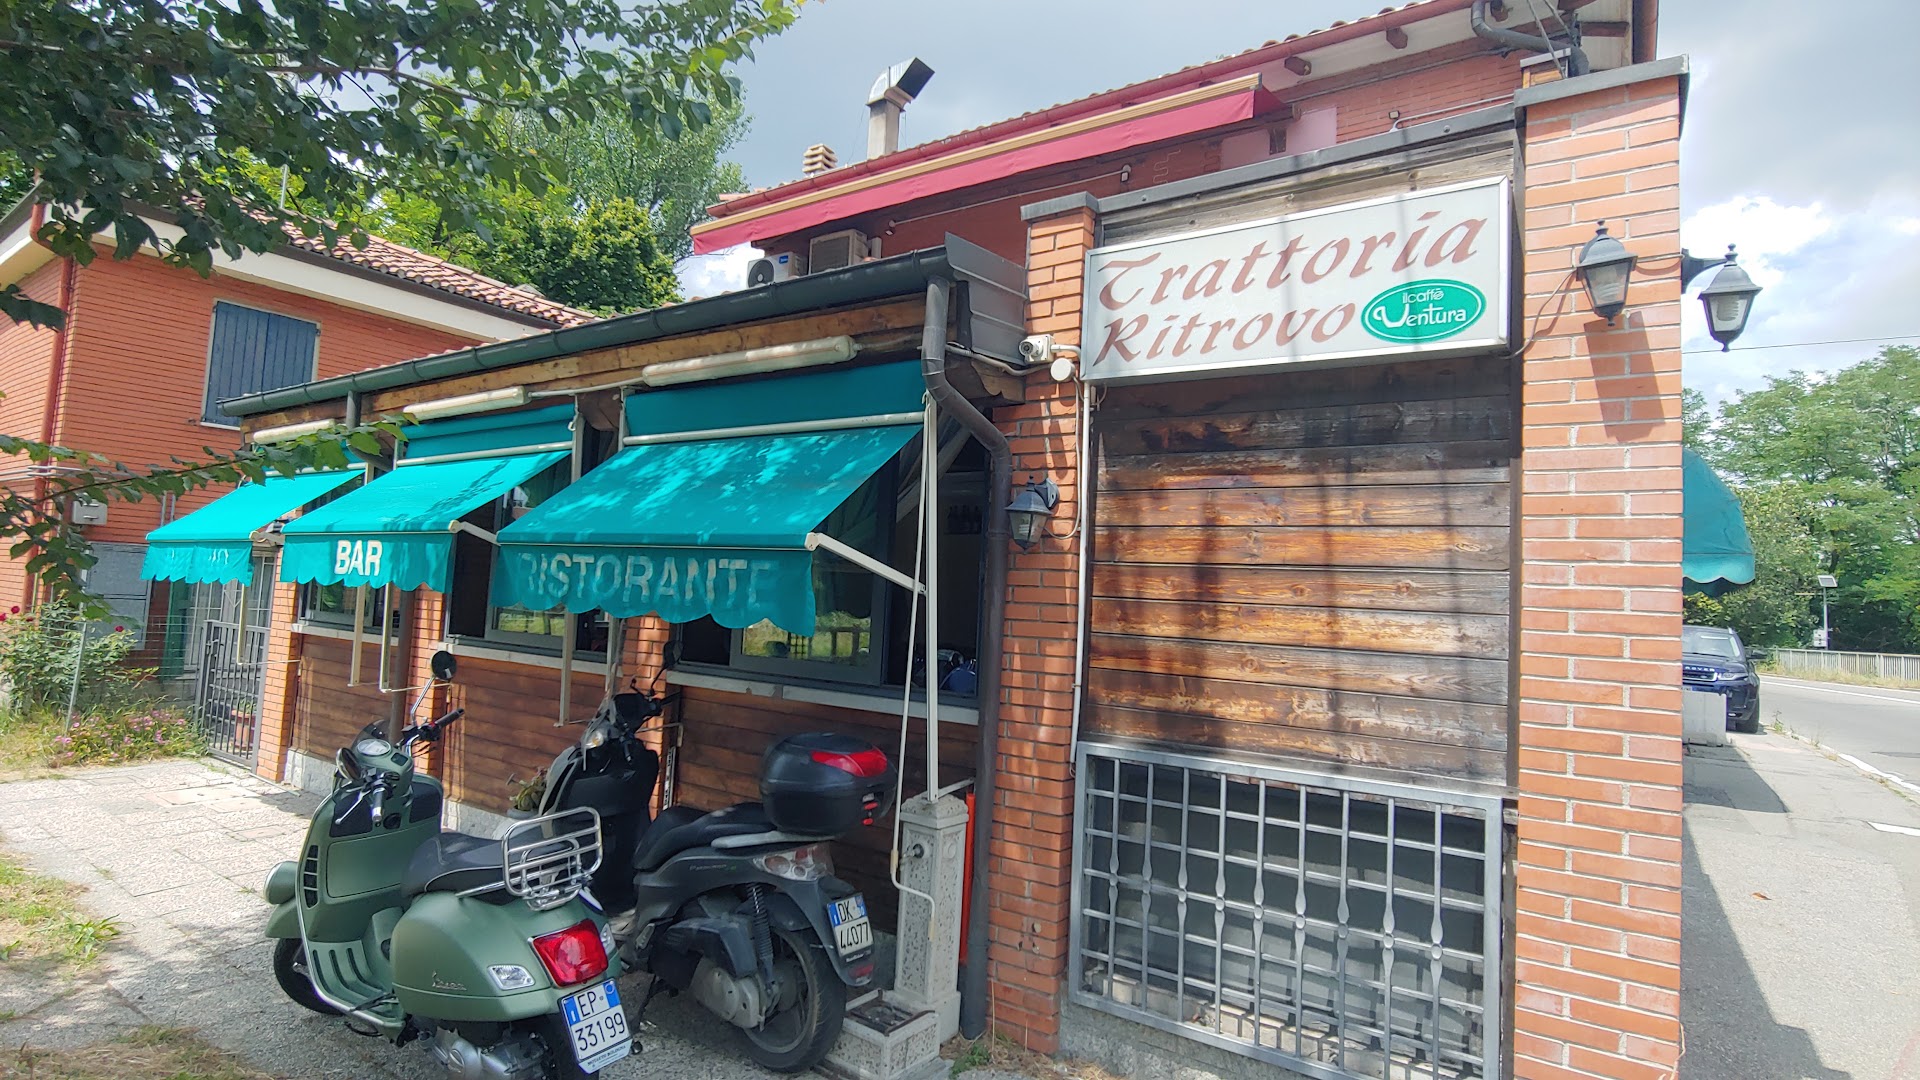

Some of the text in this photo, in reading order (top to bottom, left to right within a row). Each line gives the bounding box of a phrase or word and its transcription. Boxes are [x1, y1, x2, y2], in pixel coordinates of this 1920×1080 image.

[1098, 210, 1487, 310] Trattoria
[1372, 303, 1467, 328] Ventura
[1093, 302, 1356, 366] Ritrovo
[334, 539, 383, 576] BAR
[838, 900, 853, 922] DK
[840, 922, 869, 949] 44077
[577, 991, 597, 1018] EP
[575, 1012, 625, 1051] 33199
